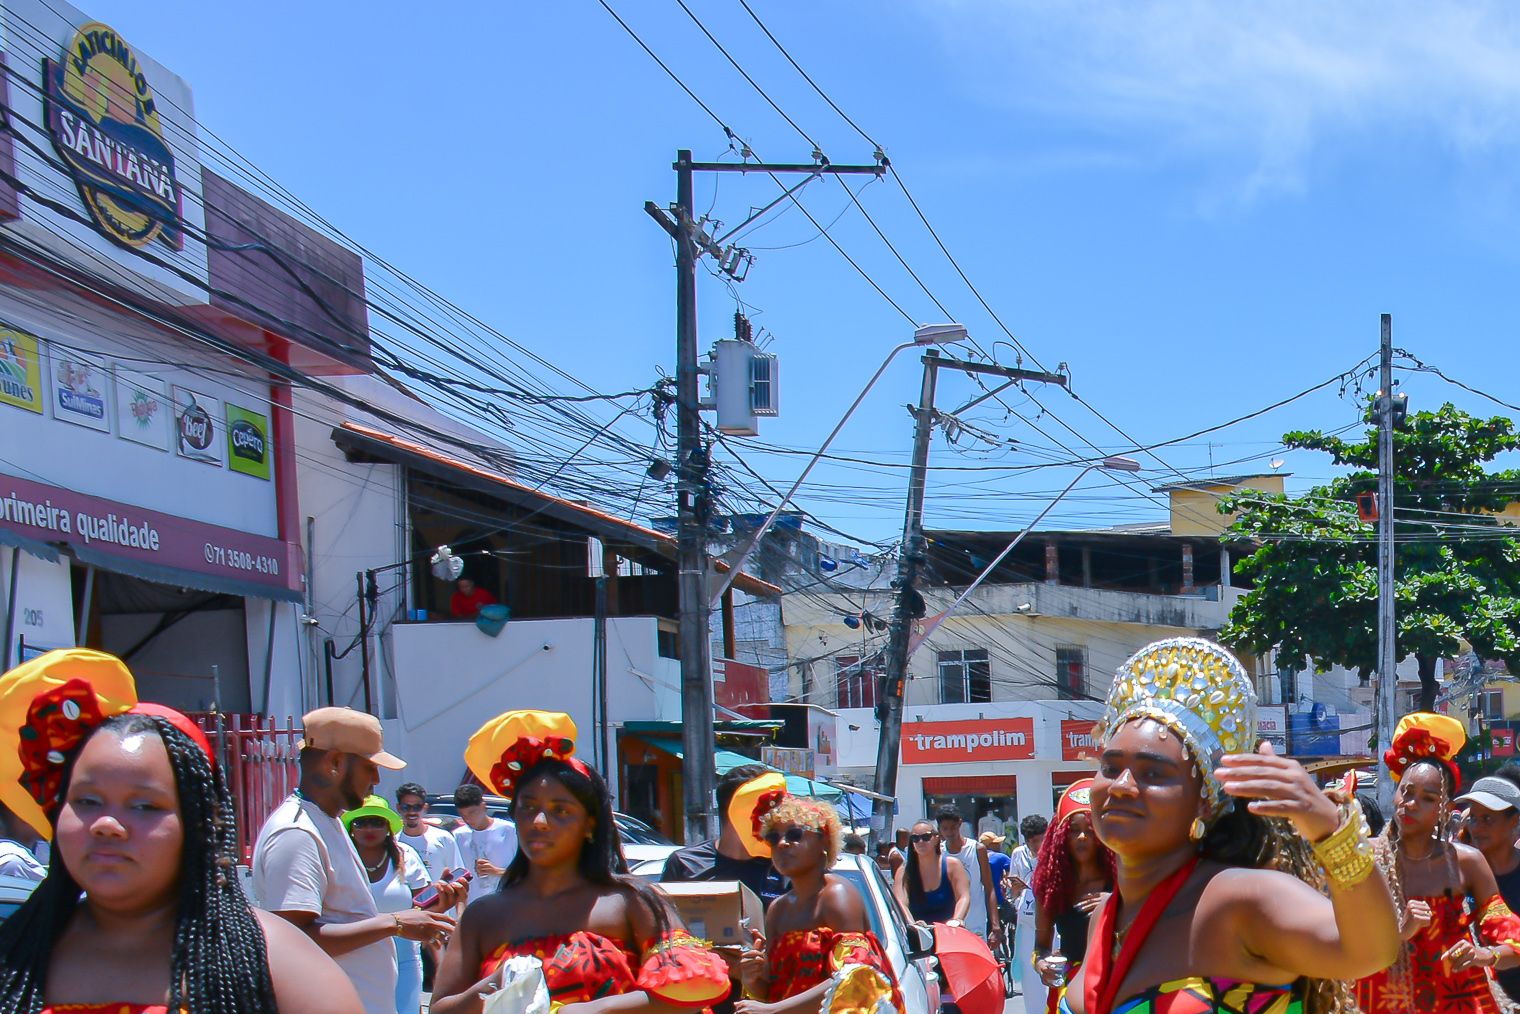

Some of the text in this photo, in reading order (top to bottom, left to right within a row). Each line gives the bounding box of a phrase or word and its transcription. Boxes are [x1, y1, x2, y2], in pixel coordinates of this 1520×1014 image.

[60, 110, 178, 203] SANTANA
[0, 379, 34, 402] unes
[183, 413, 208, 447] Beef
[232, 429, 264, 454] Cepera
[76, 511, 160, 552] qualidade
[213, 546, 279, 576] 71 3508-4310
[24, 607, 44, 628] 205
[912, 728, 1026, 753] trampolim
